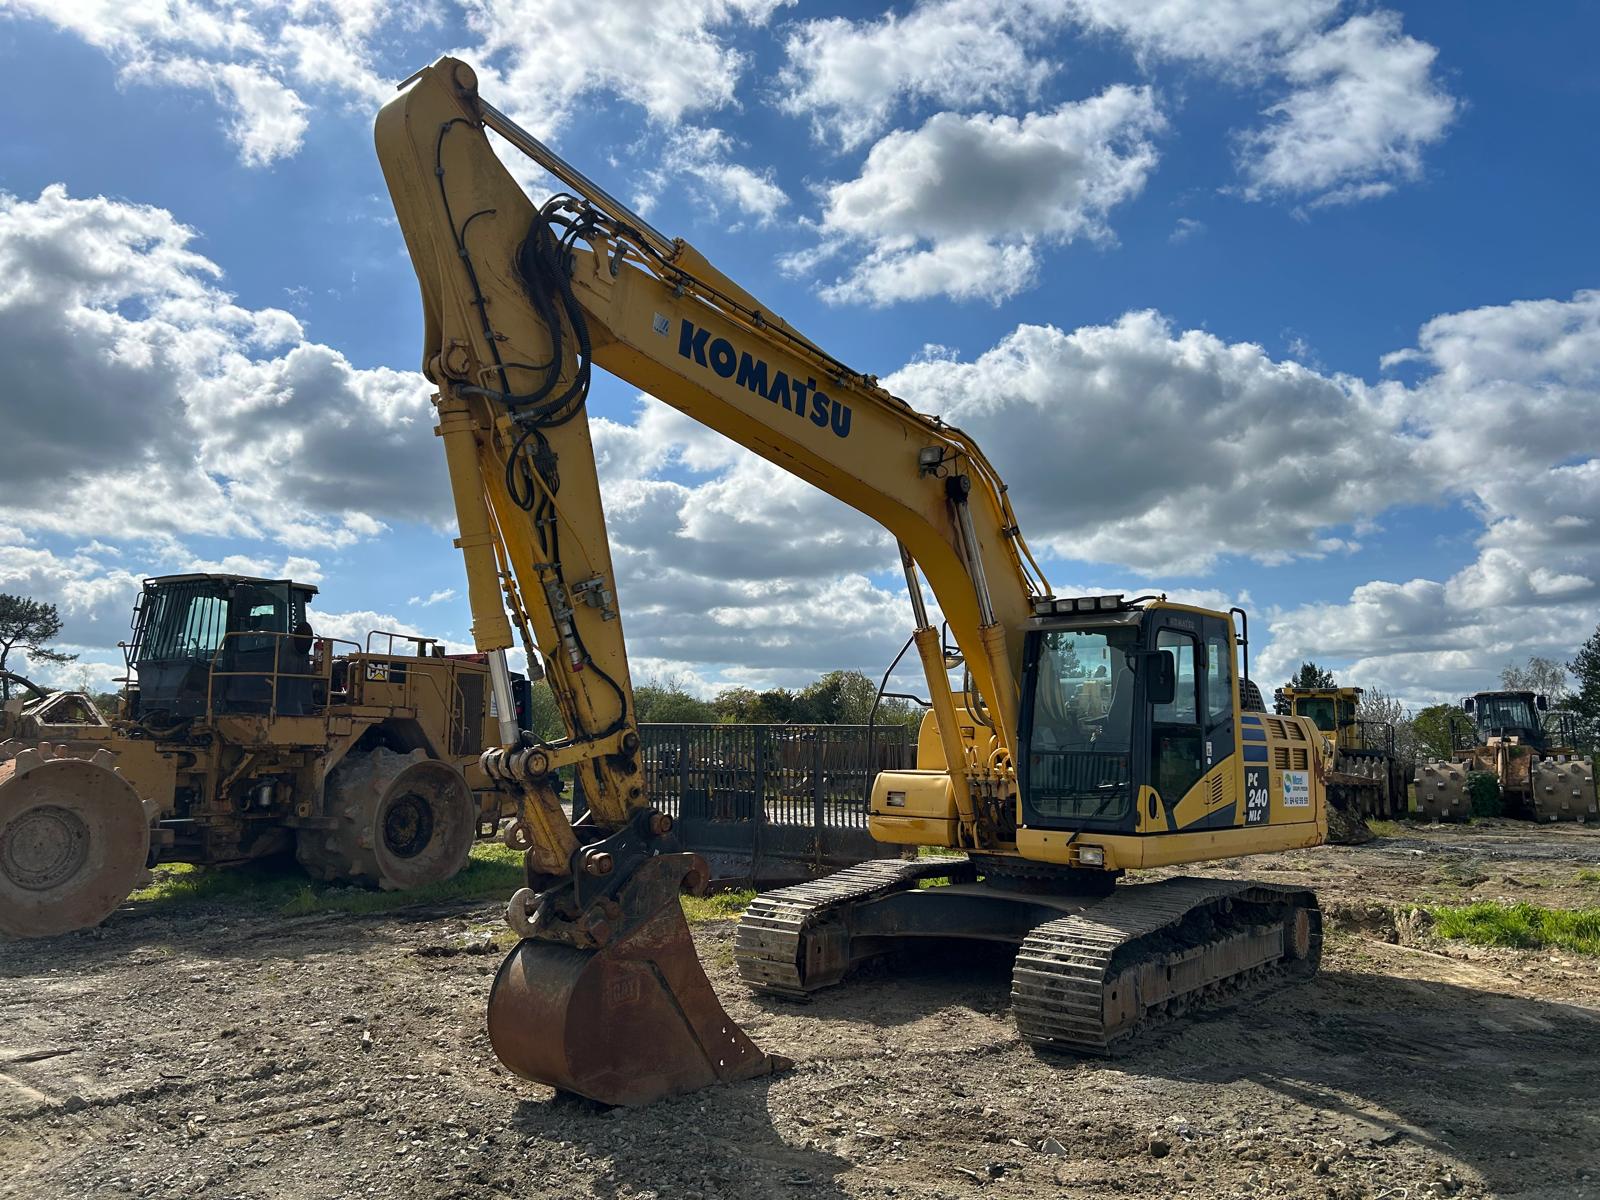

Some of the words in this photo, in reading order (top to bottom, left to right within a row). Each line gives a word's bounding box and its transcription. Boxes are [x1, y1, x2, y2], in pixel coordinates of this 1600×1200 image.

[678, 318, 852, 438] KOMATSU
[366, 663, 389, 680] CAT
[1247, 772, 1259, 787] PC
[1247, 788, 1268, 808] 240
[1247, 809, 1262, 822] NLC
